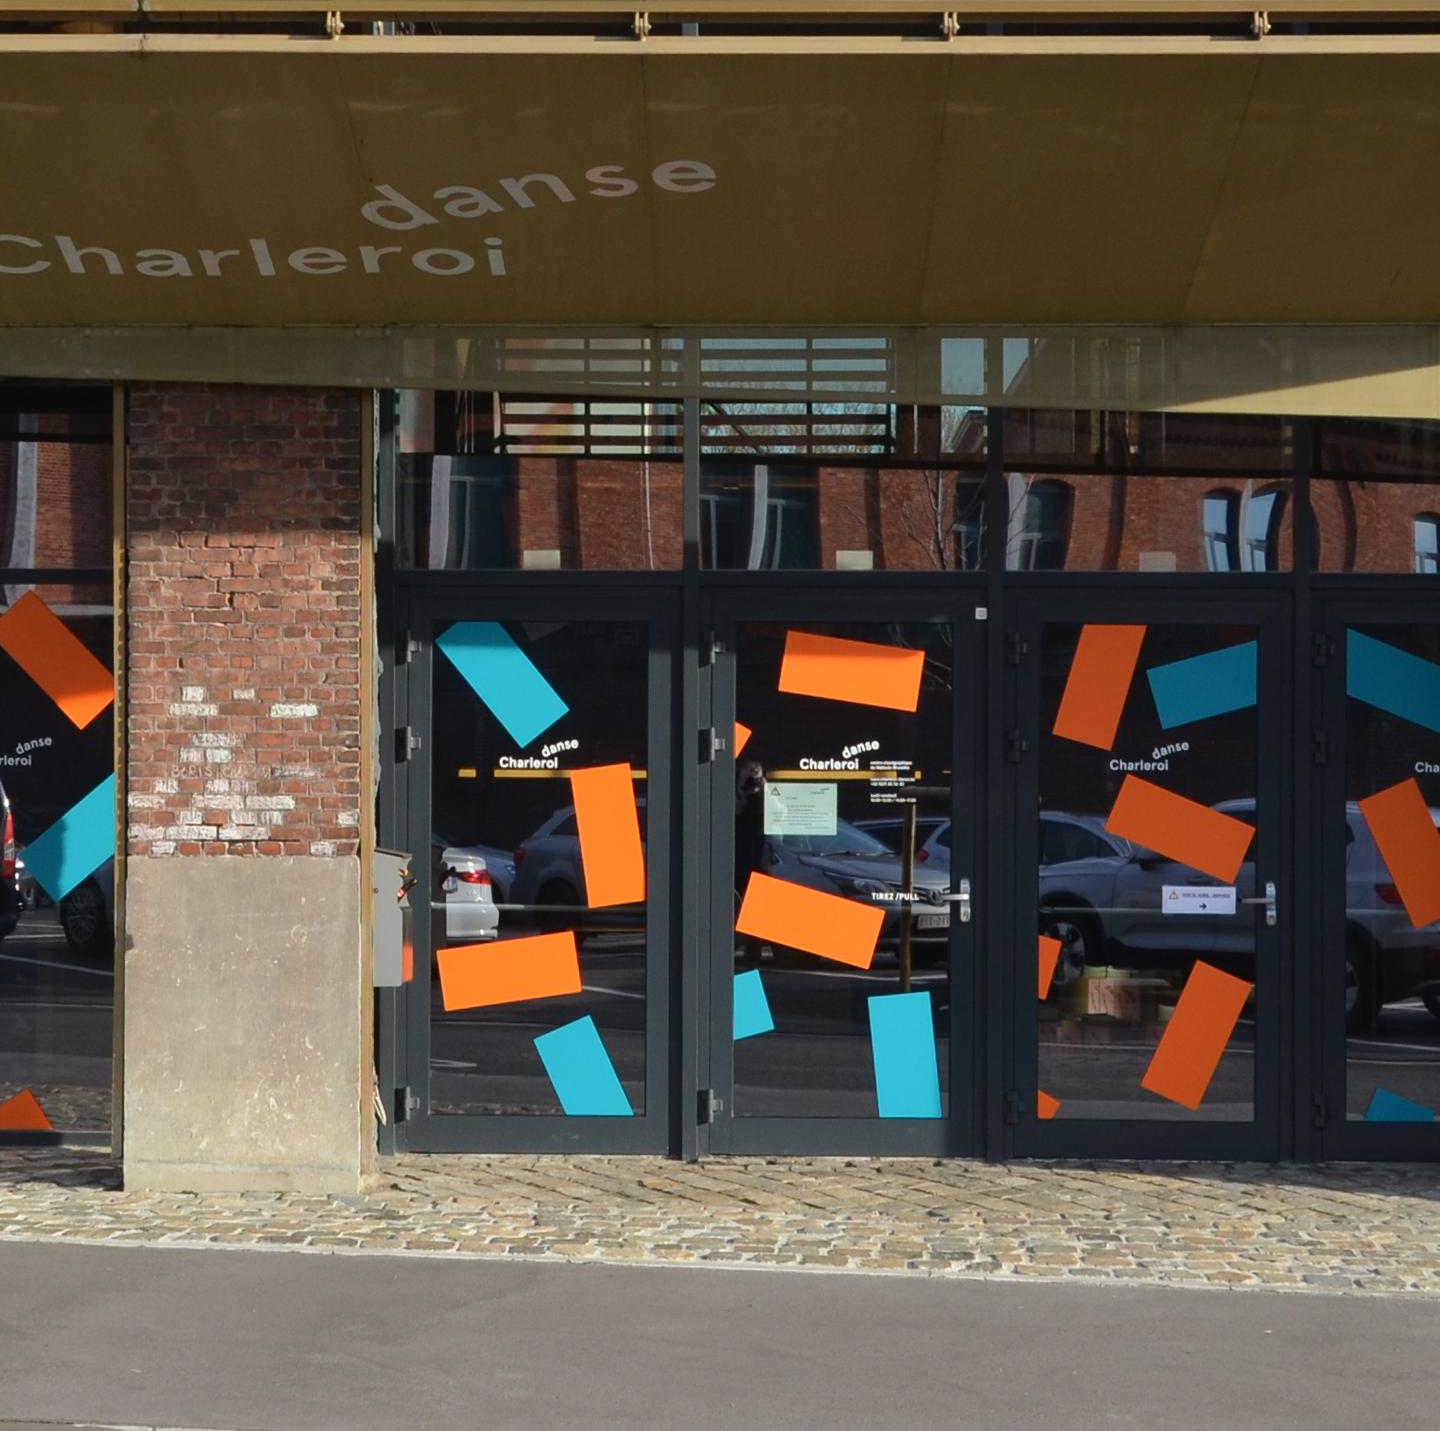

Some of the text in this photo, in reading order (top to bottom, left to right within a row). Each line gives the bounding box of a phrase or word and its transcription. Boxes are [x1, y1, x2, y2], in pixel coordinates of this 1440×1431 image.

[361, 160, 717, 231] danse
[16, 736, 53, 755] danse
[541, 738, 580, 758] danse
[841, 739, 880, 759] danse
[1152, 740, 1190, 760] danse
[498, 754, 558, 769] Charleroi
[799, 757, 859, 771] Charleroi
[1109, 758, 1169, 771] Charleroi
[871, 892, 894, 901] TIREZ
